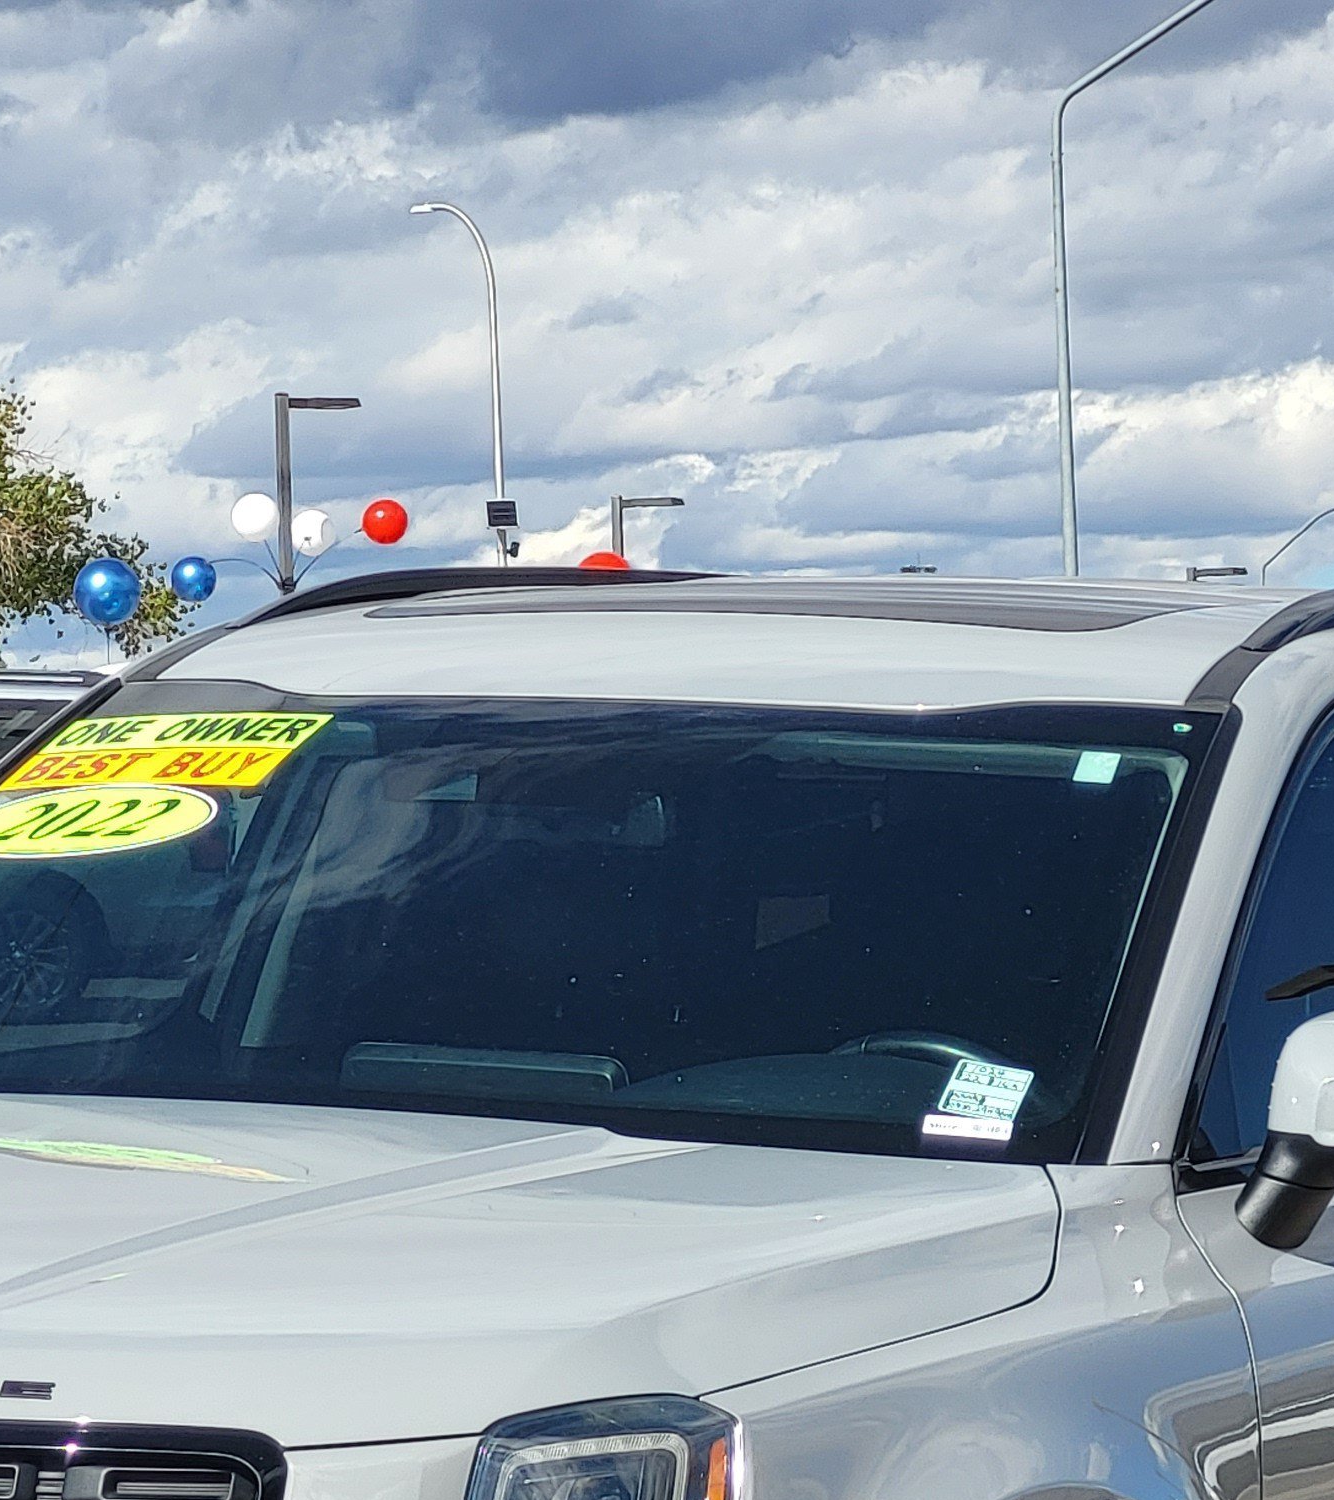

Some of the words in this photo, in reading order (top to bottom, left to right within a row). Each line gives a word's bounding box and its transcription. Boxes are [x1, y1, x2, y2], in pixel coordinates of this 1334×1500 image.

[56, 719, 158, 747] ONE
[154, 717, 319, 744] OWNER
[17, 752, 154, 783] BEST
[152, 751, 274, 780] BUY
